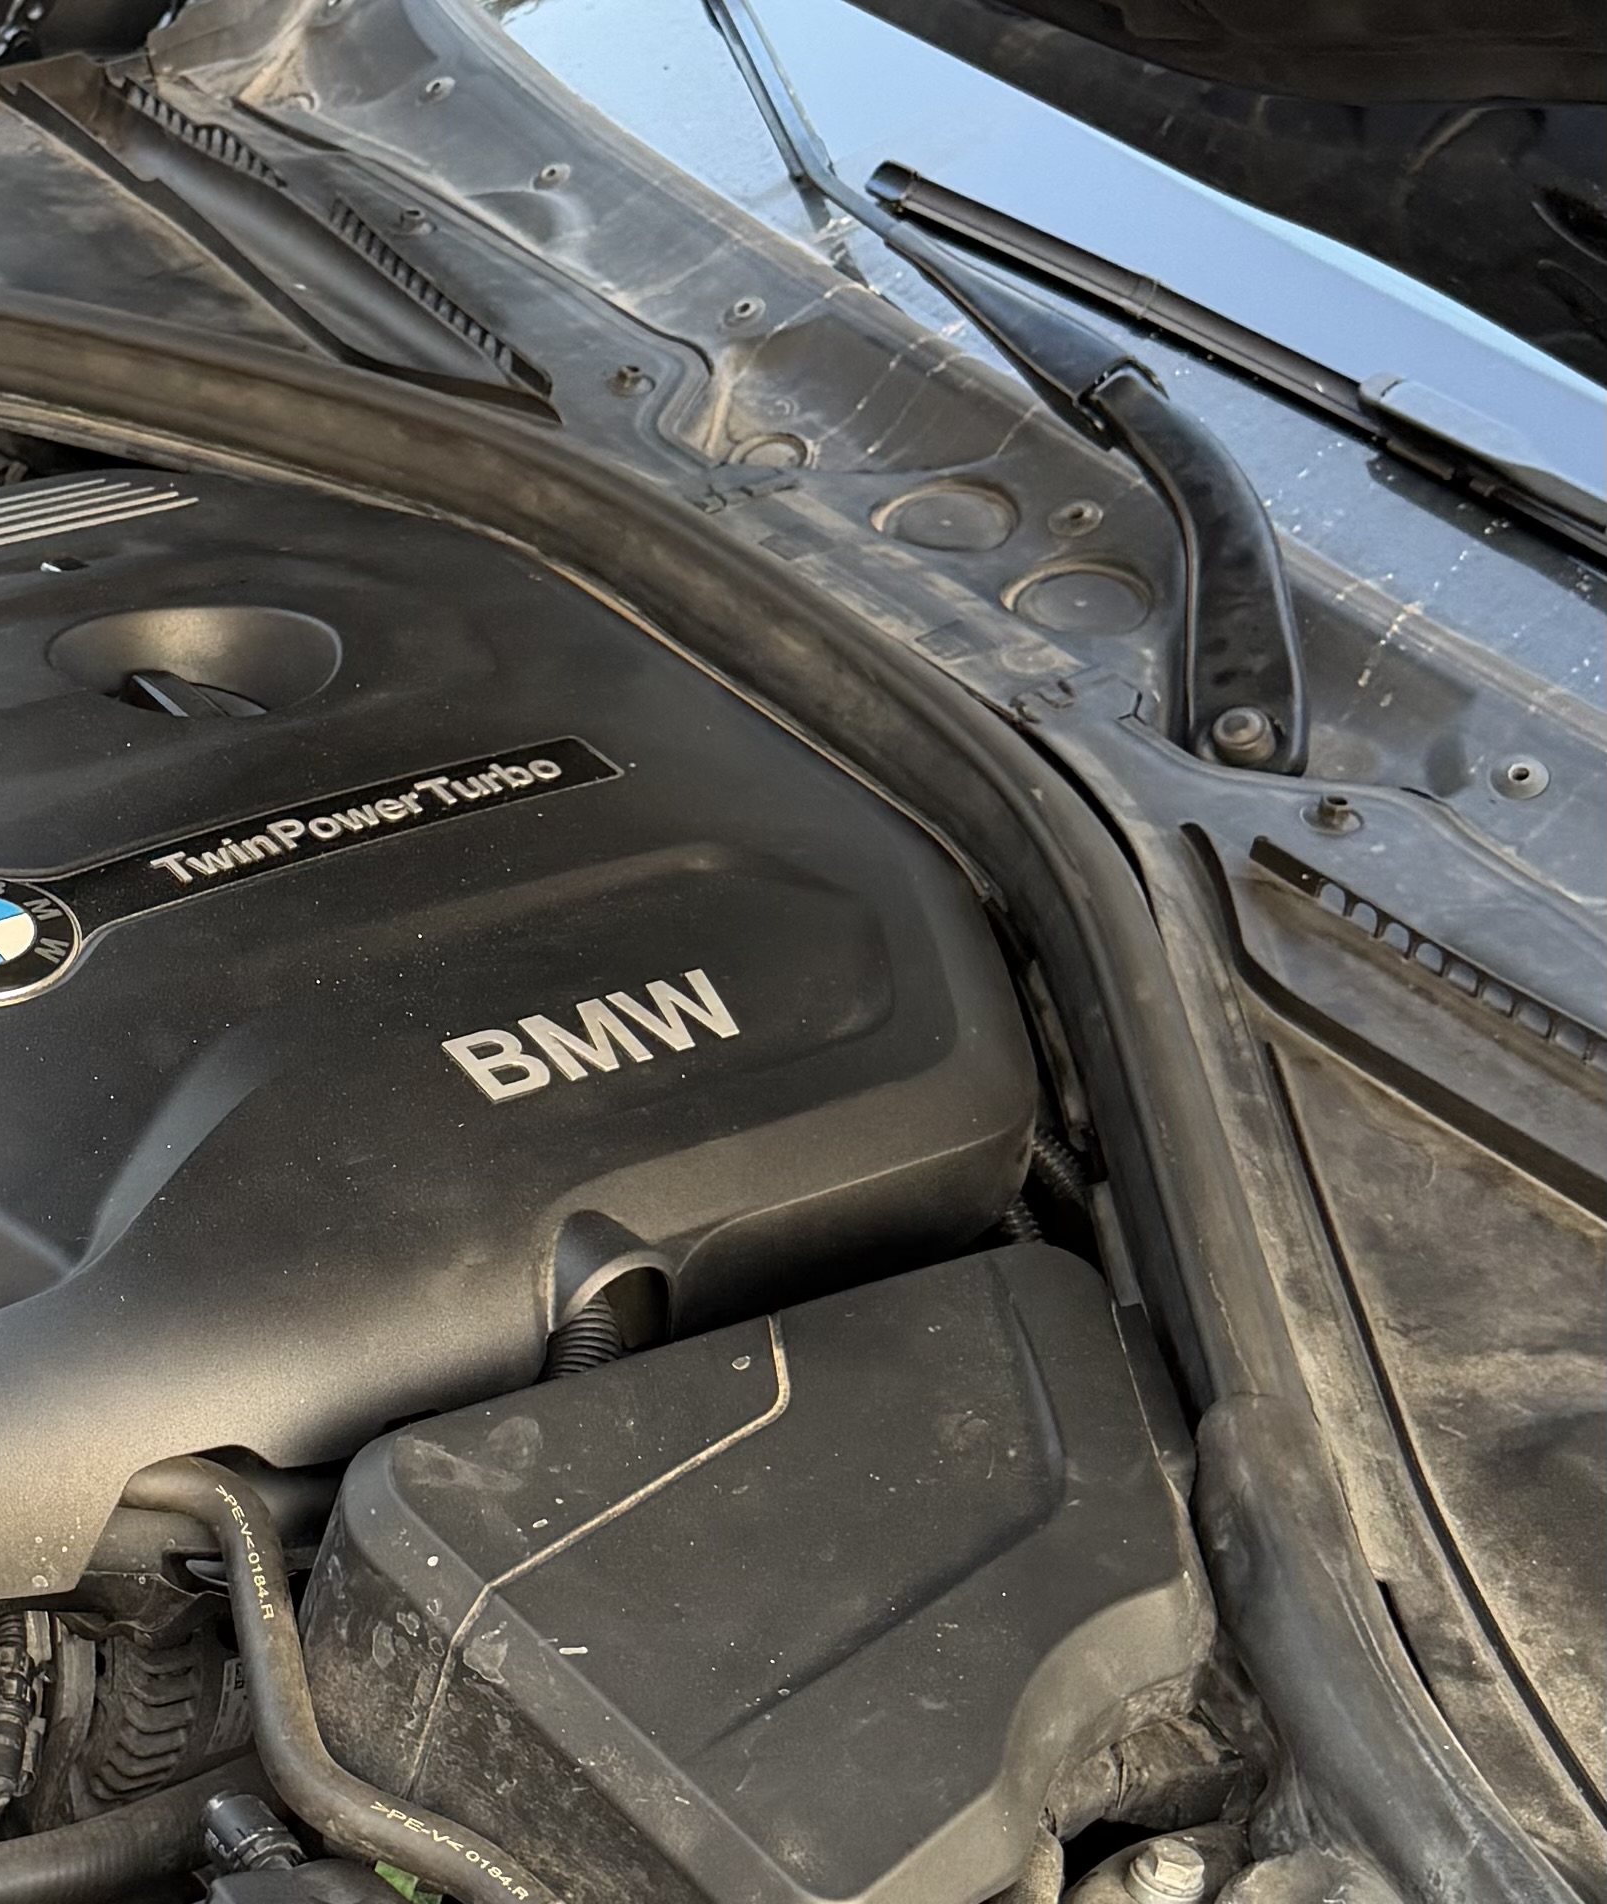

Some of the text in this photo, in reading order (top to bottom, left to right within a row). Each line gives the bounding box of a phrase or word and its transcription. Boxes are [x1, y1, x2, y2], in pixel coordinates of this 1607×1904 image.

[150, 758, 562, 886] TwinPowerTurbo
[441, 968, 740, 1105] BMW
[465, 1850, 529, 1901] 0184.R
